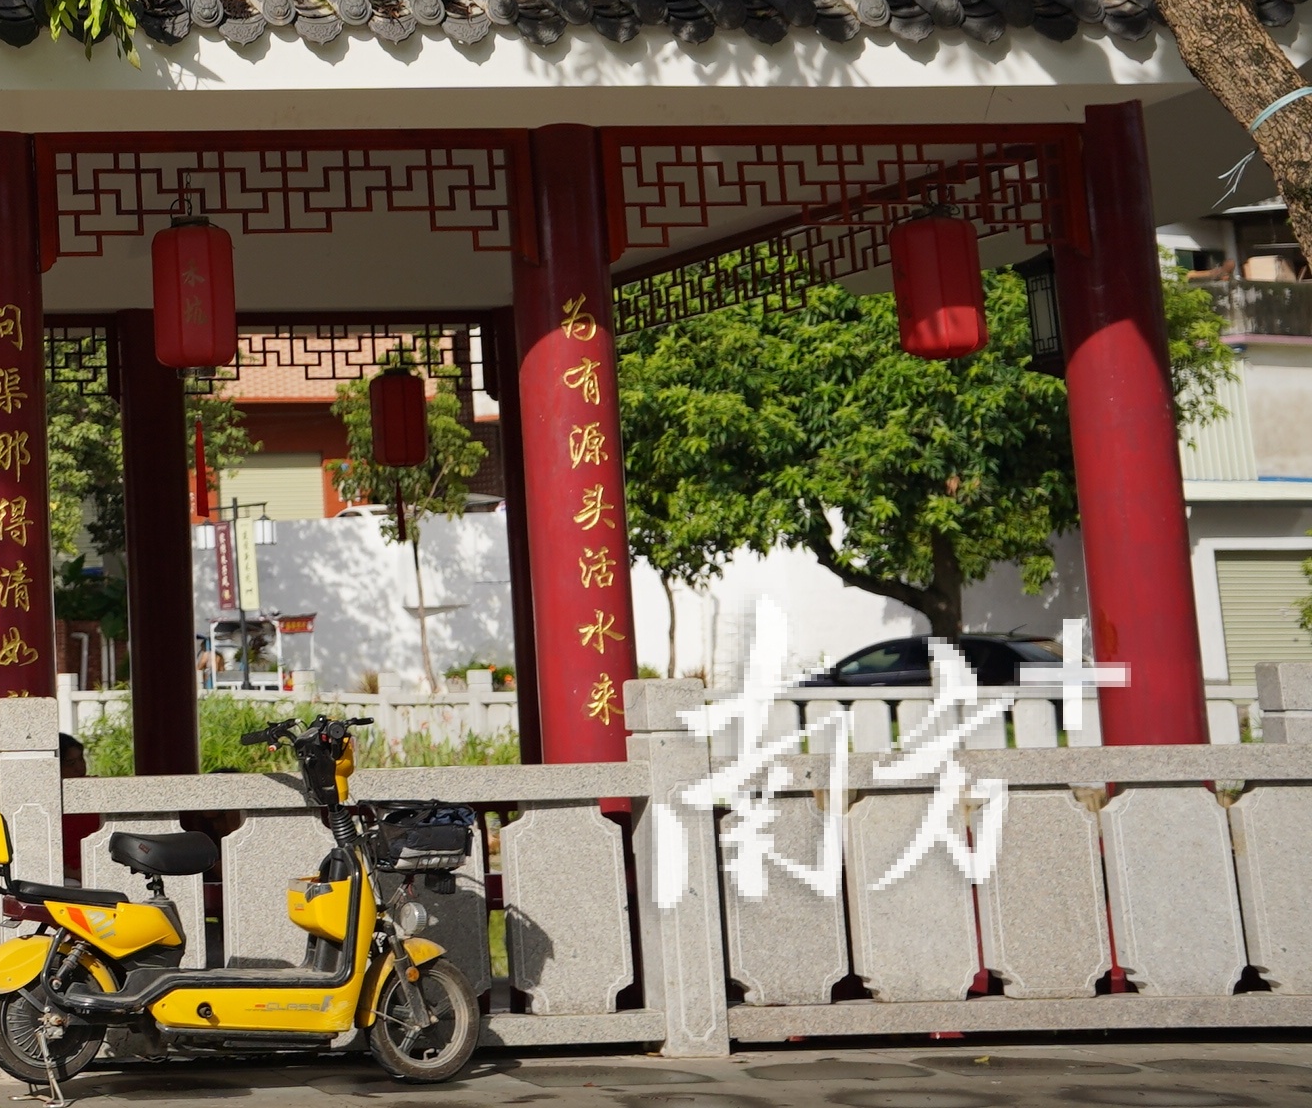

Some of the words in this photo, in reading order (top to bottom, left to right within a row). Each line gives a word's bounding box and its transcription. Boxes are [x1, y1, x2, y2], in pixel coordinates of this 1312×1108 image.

[560, 292, 625, 726] 为有源头活水来
